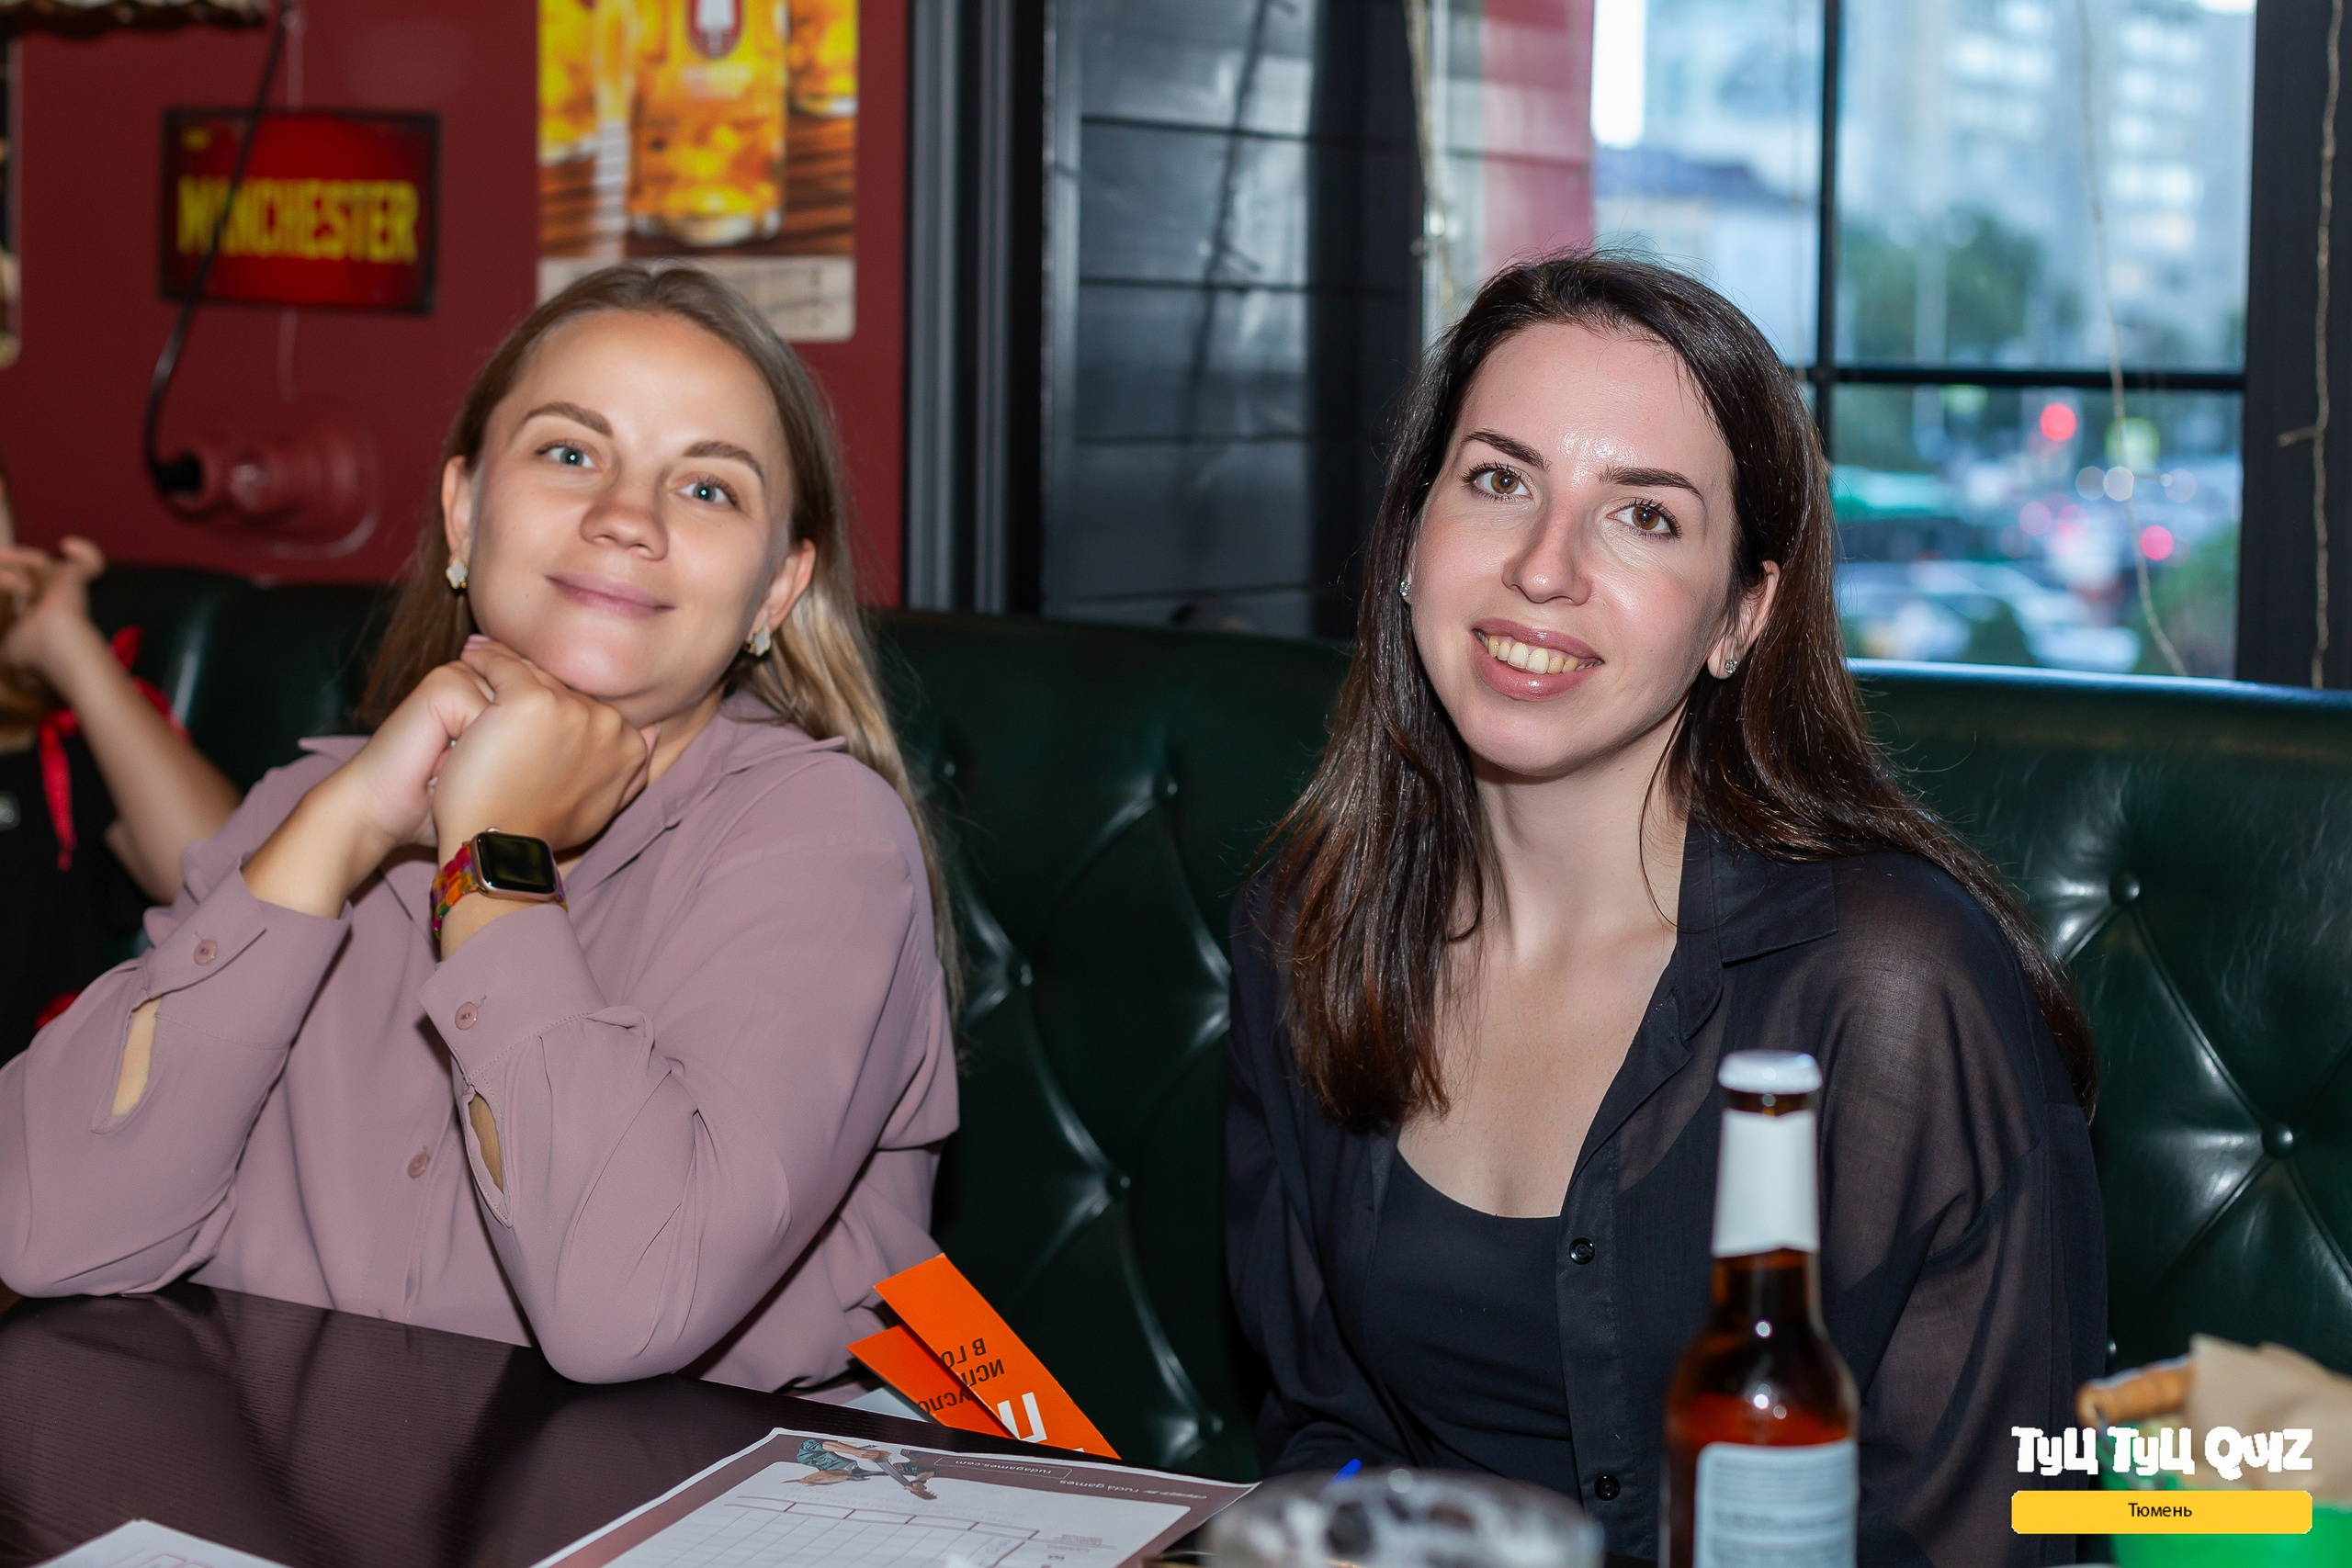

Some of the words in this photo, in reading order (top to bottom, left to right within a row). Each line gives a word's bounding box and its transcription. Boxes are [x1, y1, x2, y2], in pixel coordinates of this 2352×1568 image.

[972, 1337, 987, 1357] В
[956, 1460, 1052, 1475] rudagames.com
[1059, 1479, 1105, 1489] games
